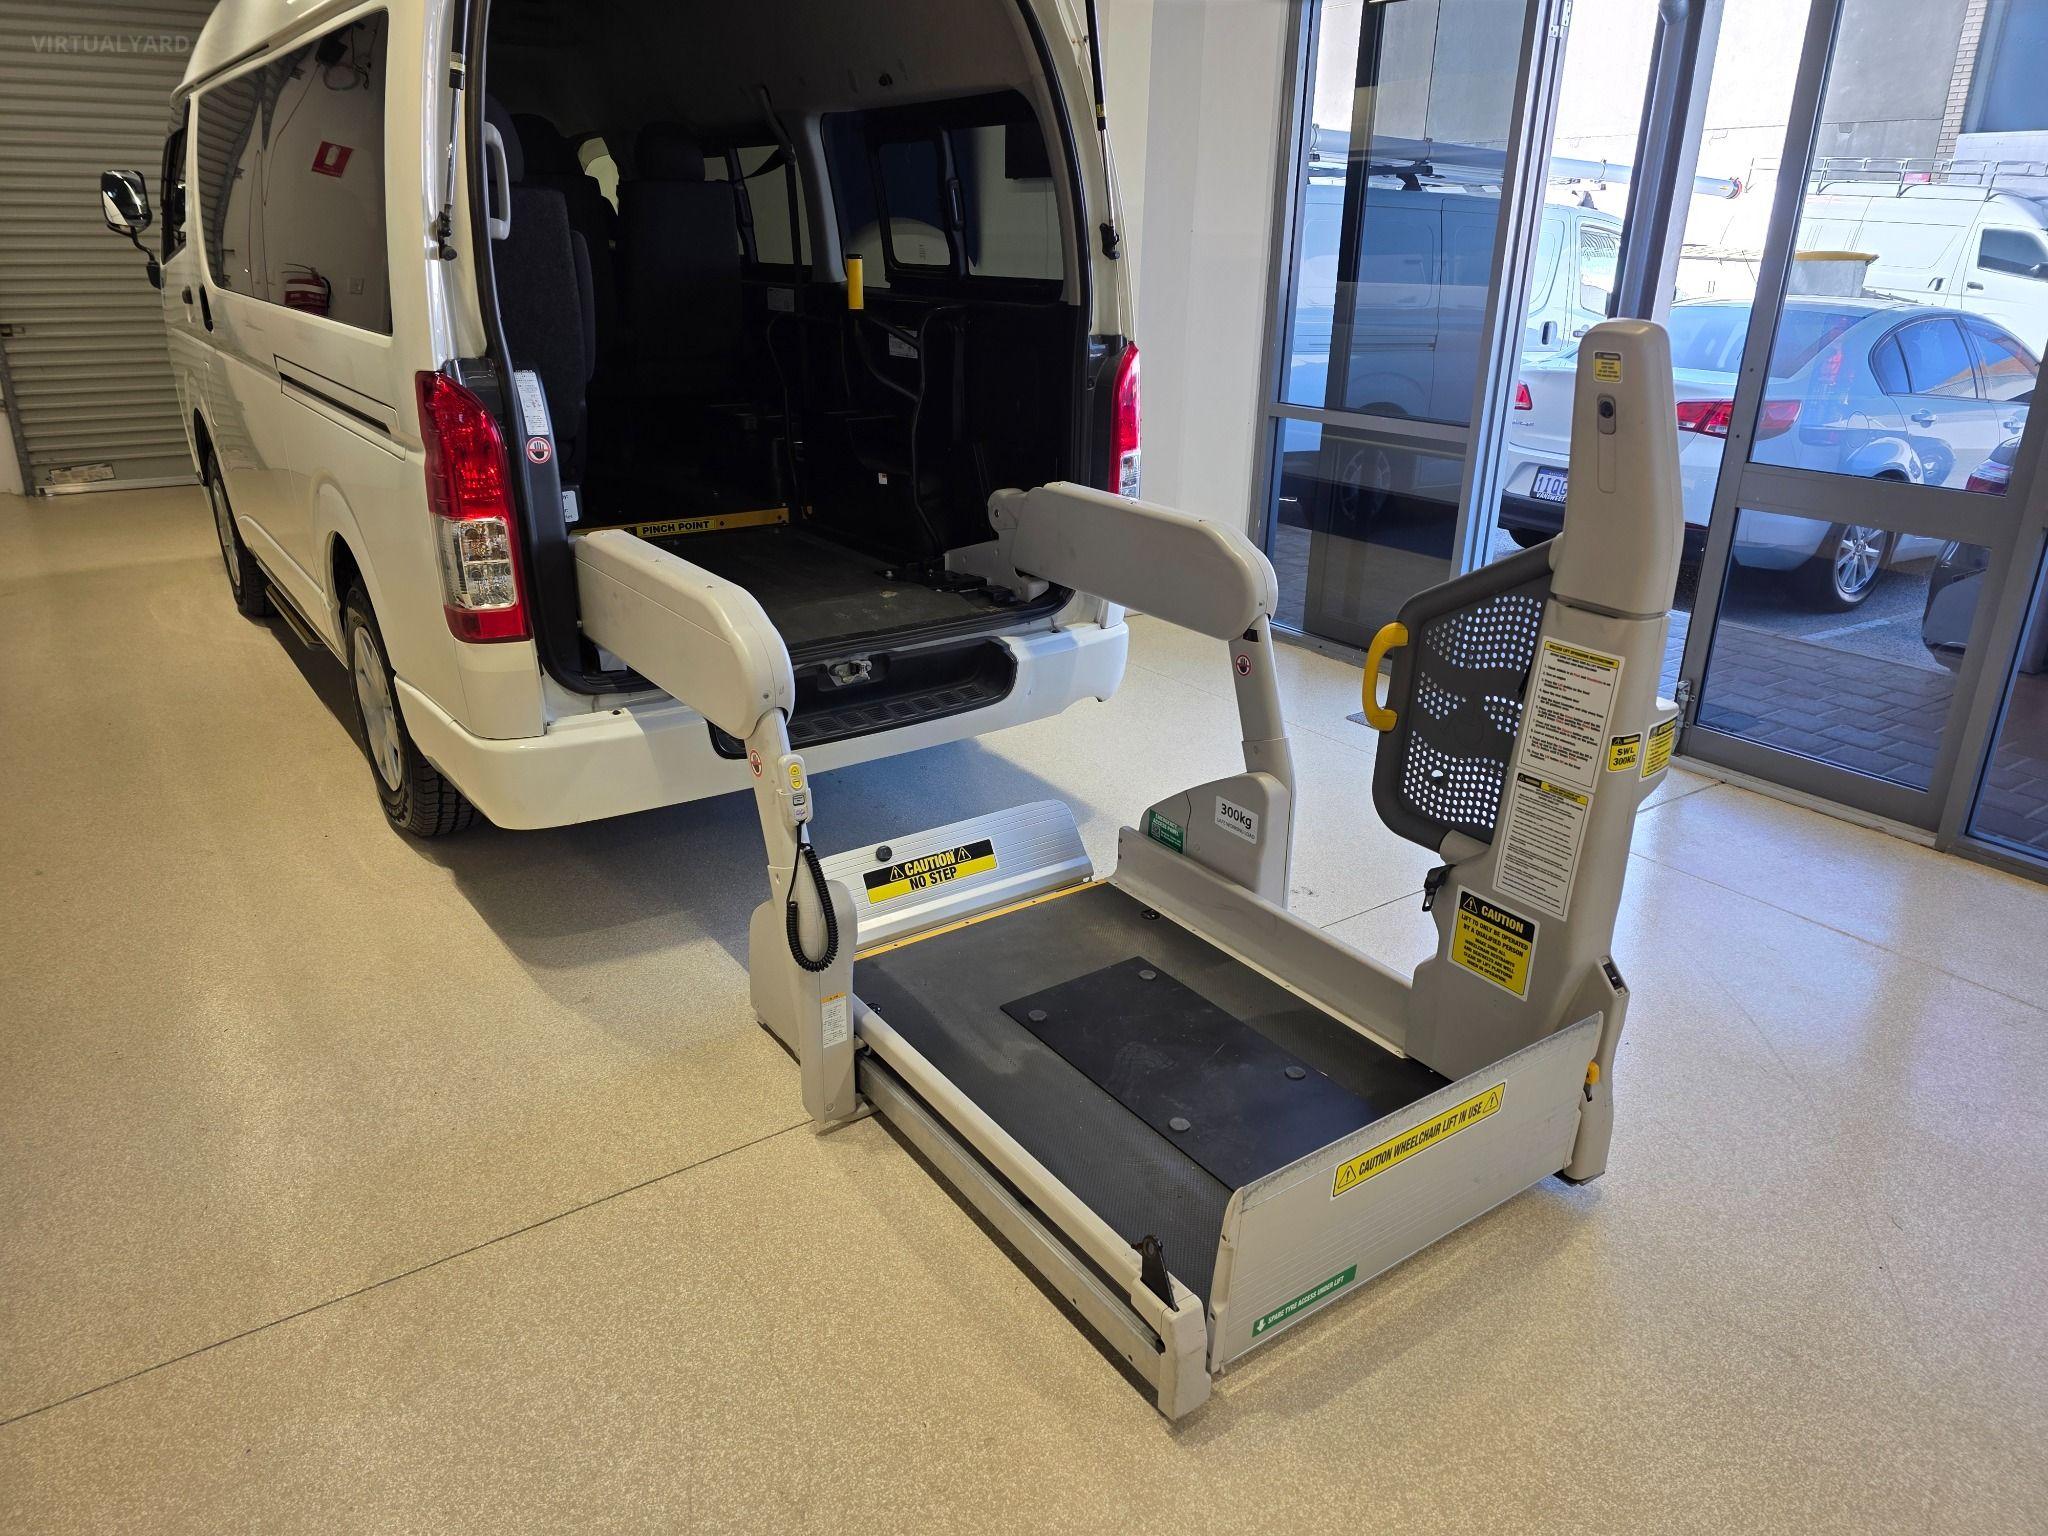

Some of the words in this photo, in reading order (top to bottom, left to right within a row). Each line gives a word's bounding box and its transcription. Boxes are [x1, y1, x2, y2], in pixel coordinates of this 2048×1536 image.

[642, 524, 675, 535] PINCH
[678, 520, 710, 530] POINT
[1616, 746, 1634, 756] SWL
[1221, 803, 1252, 830] 300kg
[904, 849, 956, 875] CAUTION
[910, 876, 926, 890] NO
[930, 867, 957, 885] STEP
[1462, 914, 1471, 922] LIFT
[1480, 923, 1492, 933] ONLY
[1502, 933, 1528, 950] OPERATED
[1481, 905, 1524, 933] CAUTION
[1503, 942, 1524, 957] PERSON
[1359, 1147, 1393, 1176] CAUTION
[1394, 1123, 1441, 1157] WHEELCHAIR
[1442, 1114, 1458, 1132] LIFT
[1458, 1110, 1467, 1124] IN
[1468, 1102, 1483, 1119] USE
[1267, 1309, 1284, 1324] SPARE
[1285, 1302, 1298, 1315] TYRE
[1298, 1291, 1317, 1307] ACCESS
[1333, 1275, 1345, 1287] LIFT
